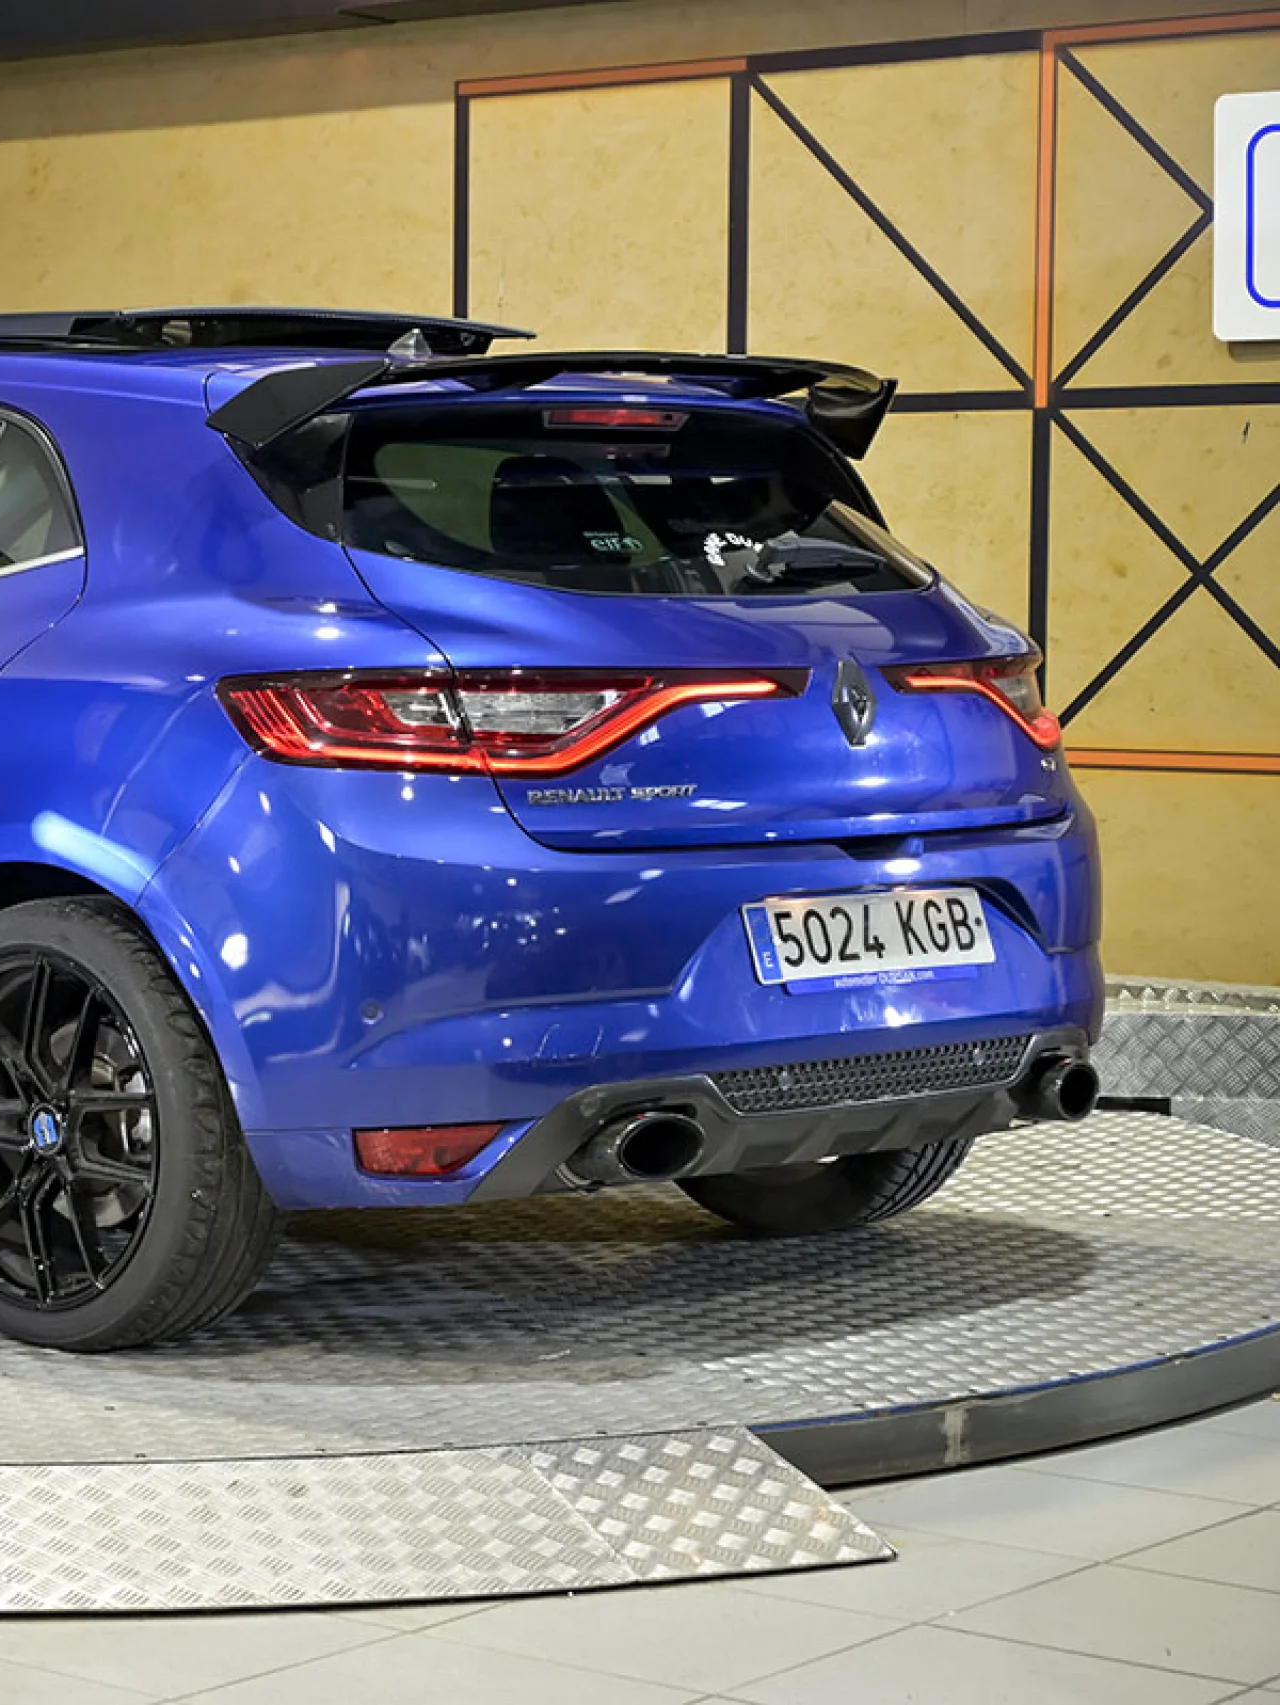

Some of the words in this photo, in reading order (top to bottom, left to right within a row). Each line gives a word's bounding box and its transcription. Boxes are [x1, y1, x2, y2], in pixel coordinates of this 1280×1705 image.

[527, 787, 625, 805] RENAULT
[630, 784, 698, 800] SPORT
[774, 904, 886, 968] 5024
[895, 897, 976, 956] KGB
[763, 951, 774, 968] E
